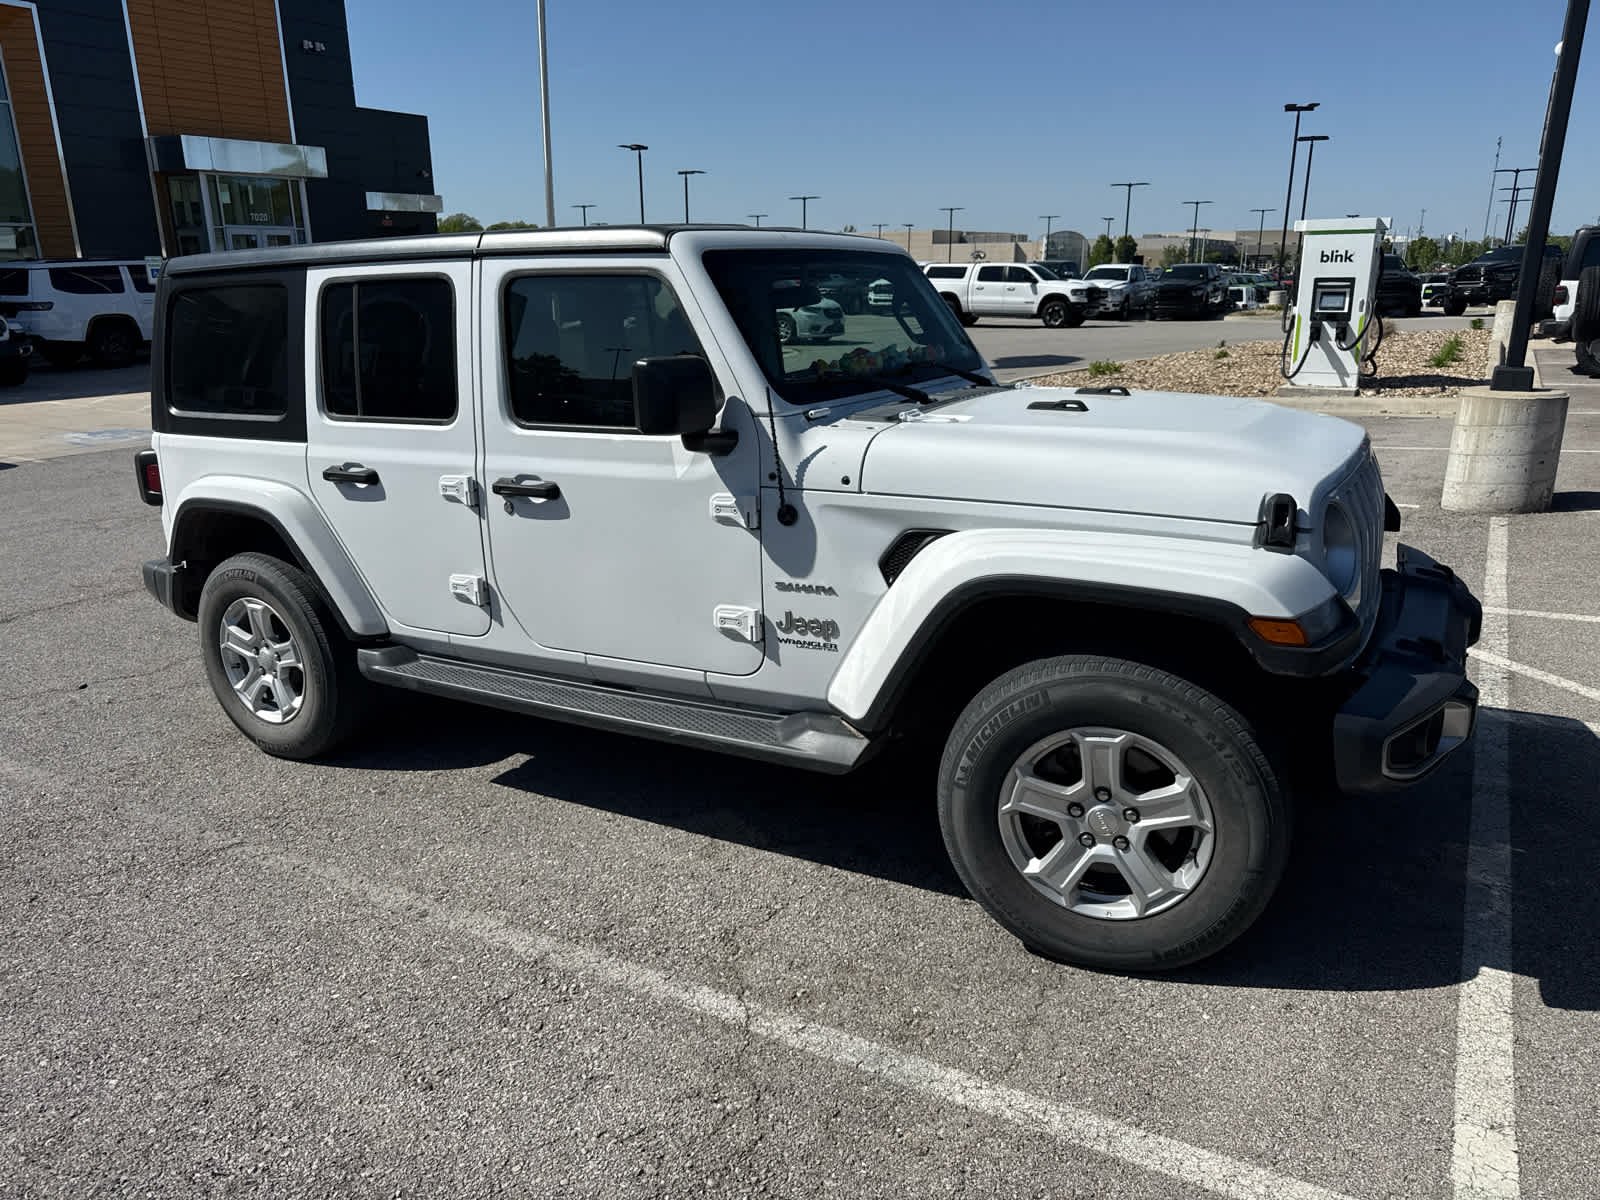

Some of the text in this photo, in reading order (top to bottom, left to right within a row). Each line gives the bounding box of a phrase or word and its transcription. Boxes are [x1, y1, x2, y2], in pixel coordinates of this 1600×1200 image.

[1320, 249, 1354, 263] blink
[775, 582, 839, 597] SAHARA
[776, 610, 840, 642] Jeep
[777, 637, 838, 650] WRANGLER
[967, 693, 1042, 762] MICHELIN
